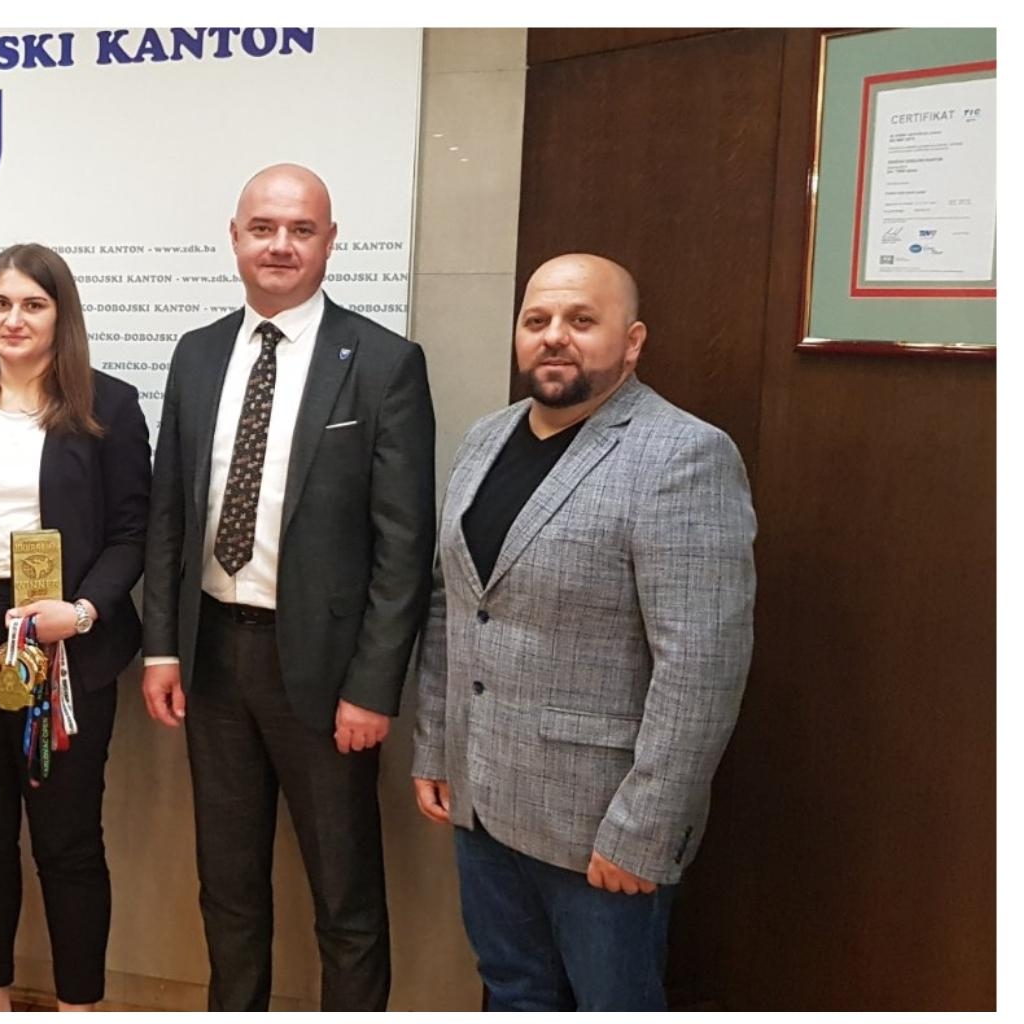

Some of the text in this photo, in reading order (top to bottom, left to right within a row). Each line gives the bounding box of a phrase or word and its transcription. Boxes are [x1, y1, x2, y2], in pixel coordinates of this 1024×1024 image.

[96, 27, 314, 64] KANTON
[890, 110, 955, 125] CERTIFIKAT
[99, 245, 145, 254] KANTON
[153, 244, 216, 253] www.zdk.ba
[352, 241, 404, 251] KANTON
[126, 275, 173, 283] KANTON
[182, 273, 240, 282] www.zdk.b
[154, 303, 201, 312] KANTON
